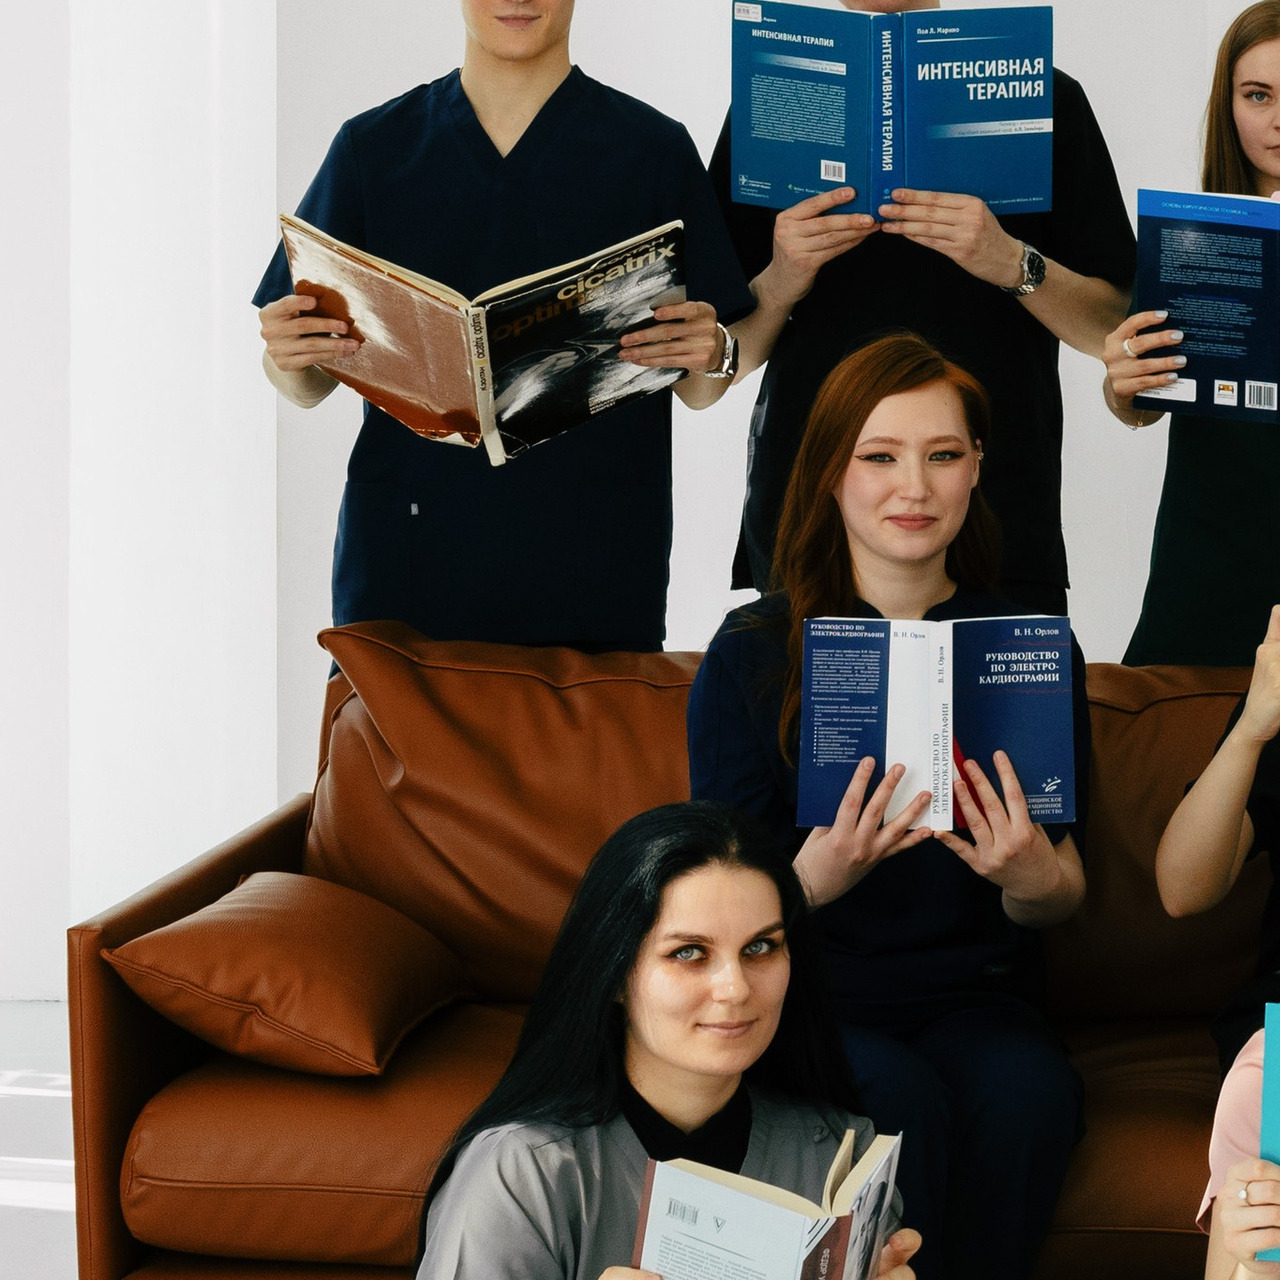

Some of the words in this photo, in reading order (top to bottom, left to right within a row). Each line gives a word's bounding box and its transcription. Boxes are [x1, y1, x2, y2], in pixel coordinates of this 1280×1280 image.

[751, 29, 802, 43] ИНТЕНСИВНАЯ
[803, 36, 834, 47] ТЕРАПИЯ
[881, 30, 892, 117] ИНТЕНСИВНАЯ
[917, 57, 1044, 81] ИНТЕНСИВНАЯ
[967, 80, 1044, 100] ТЕРАПИЯ
[882, 119, 893, 171] ТЕРАПИЯ
[557, 243, 676, 301] cicatrix
[810, 623, 854, 631] РУКОВОДСТВО
[810, 630, 885, 638] ЭЛЕКТРОКАРДИОГРАФИИ
[1014, 628, 1023, 636] В.
[1024, 628, 1033, 636] Н.
[1034, 627, 1059, 637] Орлов
[985, 651, 1059, 661] РУКОВОДСТВО
[991, 664, 1006, 673] ПО
[1009, 662, 1060, 672] ЭЛЕКТРО-
[979, 673, 1060, 685] КАРДИОГРАФИИ
[933, 733, 940, 748] ПО
[819, 1248, 831, 1275] ФЕДОР
